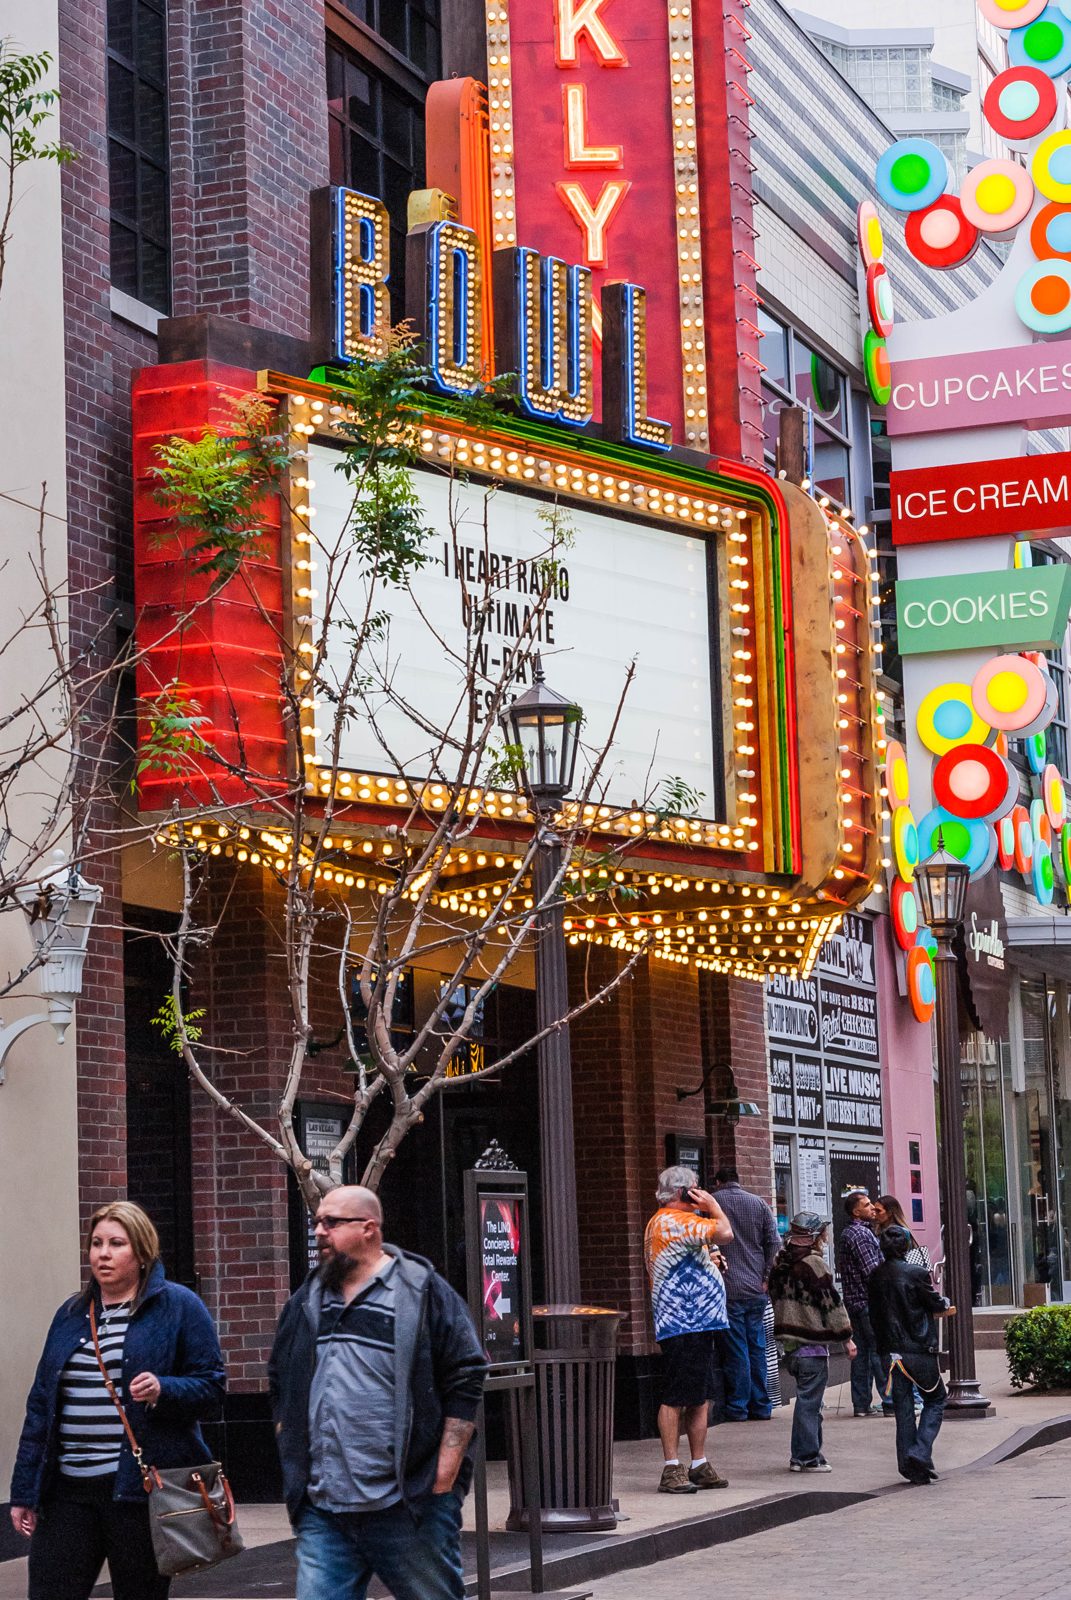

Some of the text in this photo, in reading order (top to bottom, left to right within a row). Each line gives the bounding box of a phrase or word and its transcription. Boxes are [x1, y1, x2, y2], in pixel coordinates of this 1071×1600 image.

[334, 185, 673, 452] BOWL
[892, 362, 1071, 411] CUPCAKES
[896, 475, 1069, 520] ICE CREAM
[903, 590, 1049, 629] COOKIES
[792, 979, 817, 1002] DAYS
[829, 992, 841, 1006] HAVE
[841, 995, 850, 1008] THE
[850, 994, 875, 1014] BEST
[841, 1012, 876, 1037] CHICKEN
[823, 1065, 848, 1094] LIVE
[848, 1069, 881, 1099] MUSIC
[796, 1095, 816, 1121] PARTY
[486, 1221, 497, 1234] The
[484, 1237, 509, 1251] Concierge
[482, 1253, 517, 1266] Total Rewards
